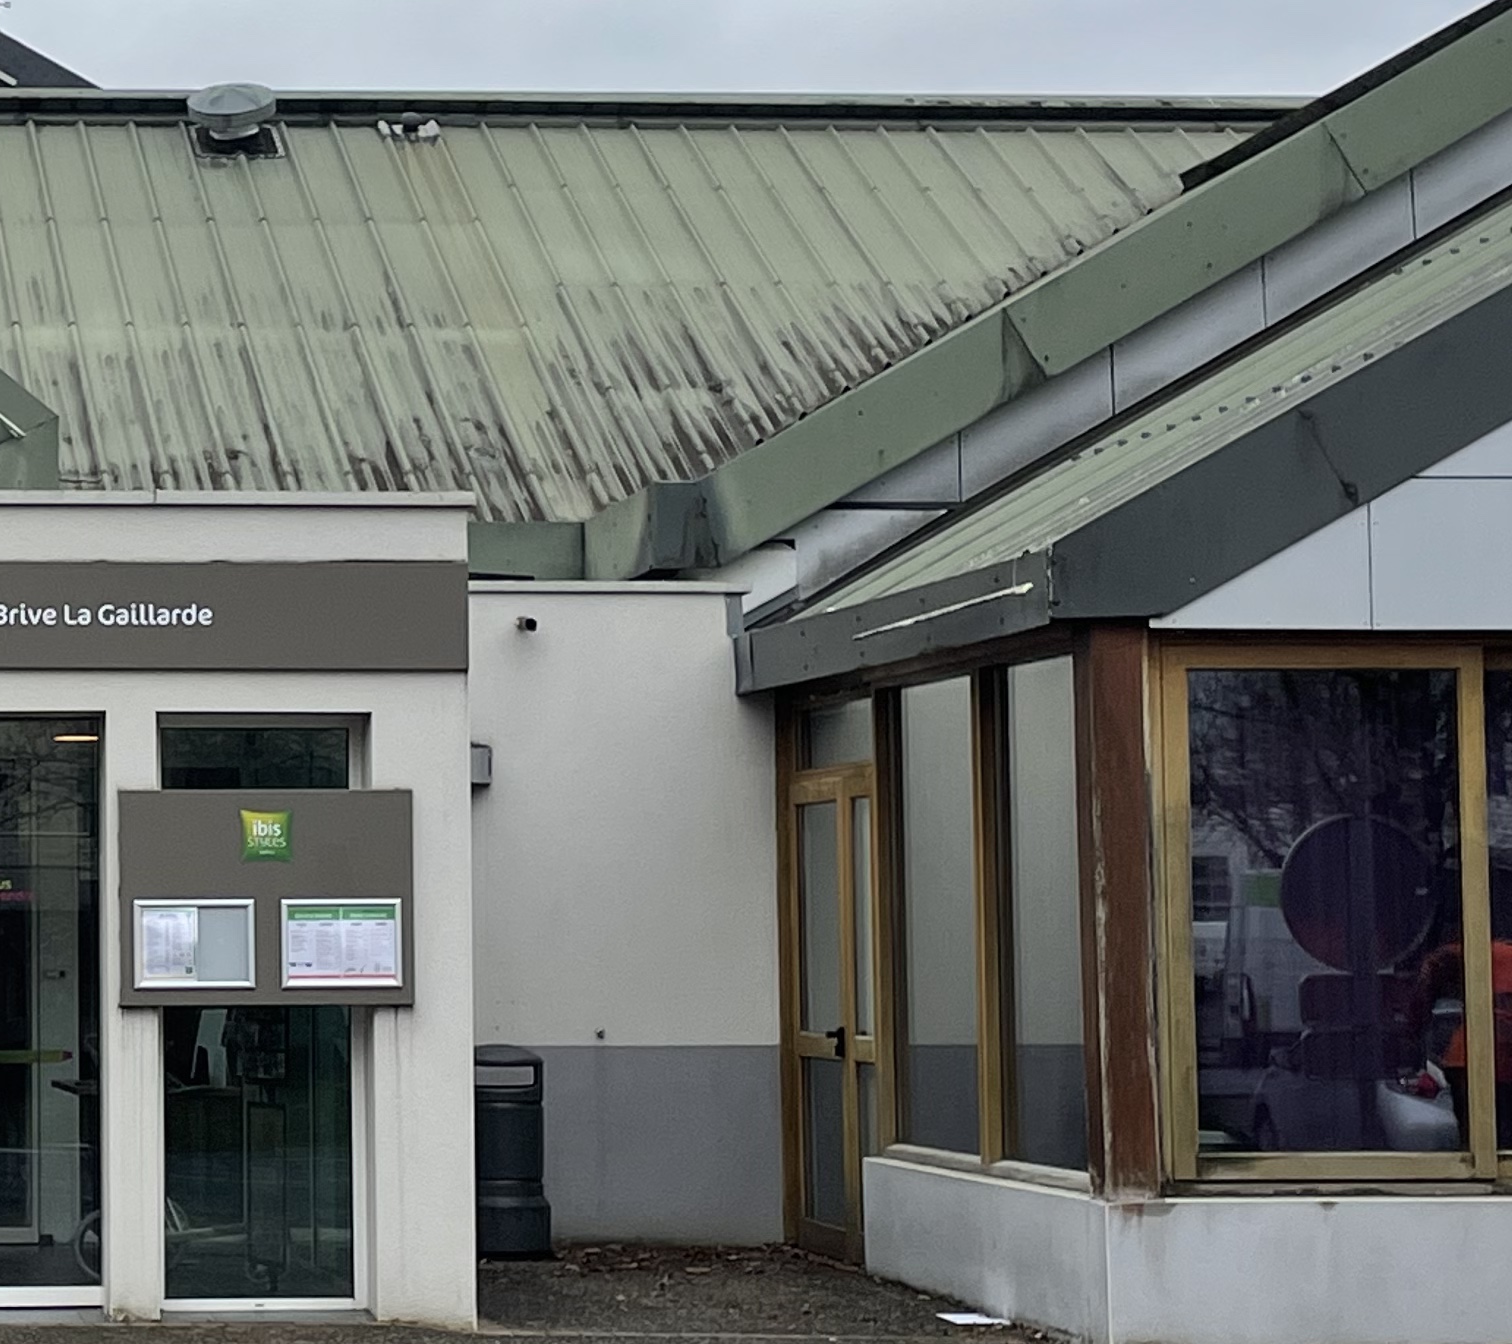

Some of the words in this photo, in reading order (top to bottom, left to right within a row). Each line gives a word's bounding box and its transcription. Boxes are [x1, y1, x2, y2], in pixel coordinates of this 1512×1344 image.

[64, 603, 92, 626] La
[97, 603, 214, 626] Gaillarde
[252, 819, 282, 836] ibis
